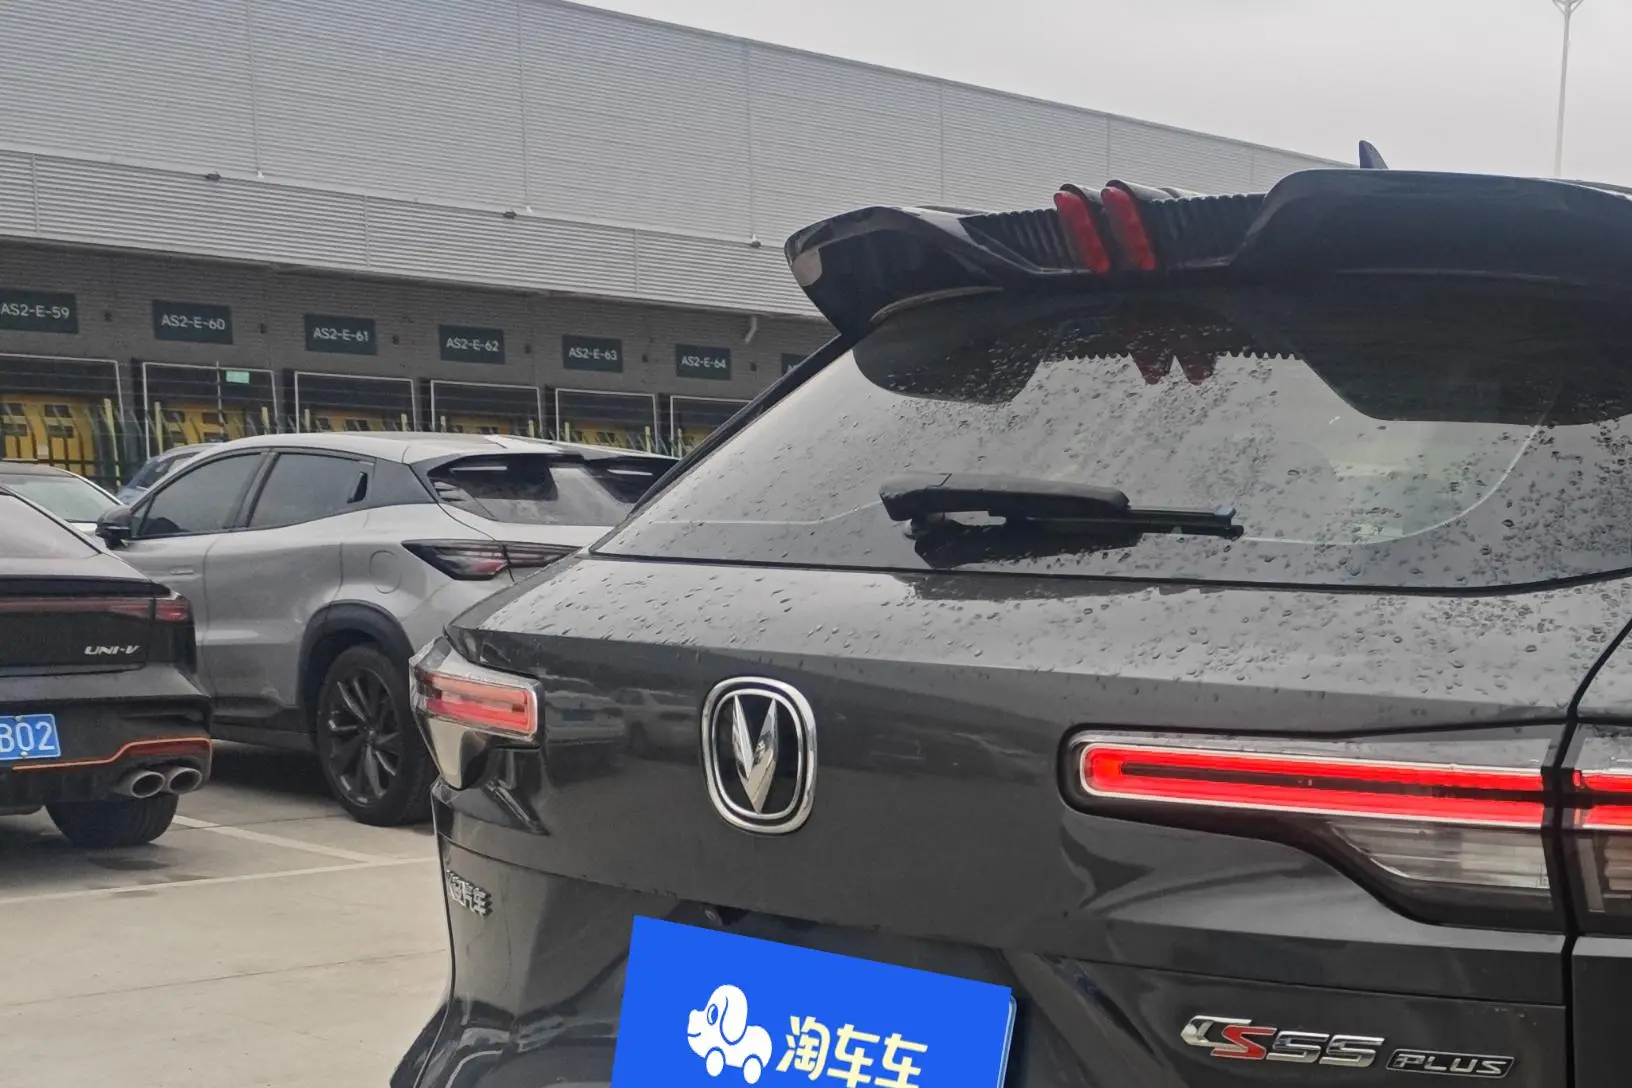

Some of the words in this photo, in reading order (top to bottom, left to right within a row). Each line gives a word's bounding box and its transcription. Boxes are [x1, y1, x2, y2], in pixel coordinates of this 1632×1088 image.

[1, 303, 70, 319] AS2-E-59
[161, 314, 226, 330] AS2-E-60
[313, 327, 369, 342] AS2-E-61
[446, 337, 500, 352] AS2-E-62
[568, 347, 618, 361] AS2-E-63
[681, 355, 727, 370] AS2-E-64
[84, 645, 140, 655] UNI-V
[1180, 1015, 1385, 1067] CS55
[1393, 1053, 1508, 1076] PLUS
